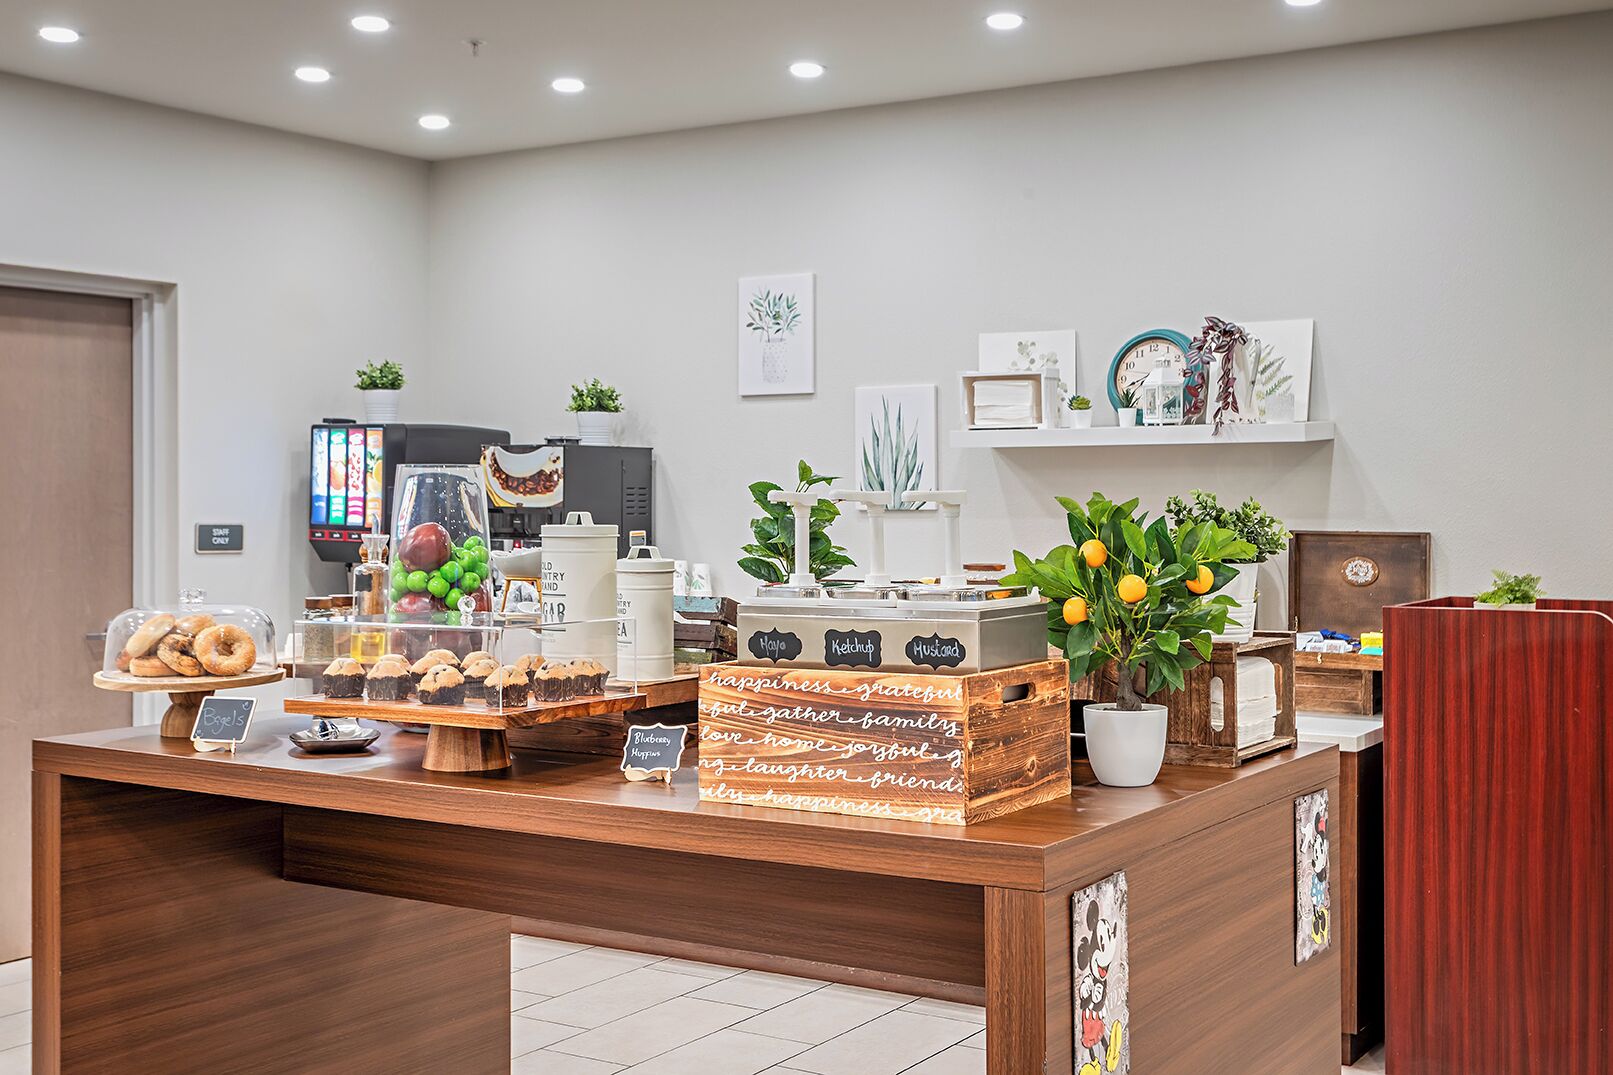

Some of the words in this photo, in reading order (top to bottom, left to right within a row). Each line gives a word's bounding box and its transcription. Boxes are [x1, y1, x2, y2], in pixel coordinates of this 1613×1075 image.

[1135, 350, 1144, 358] 11
[1149, 344, 1159, 352] 12
[1166, 346, 1170, 354] 1
[1125, 361, 1135, 370] 10
[1174, 355, 1180, 363] 2
[1121, 375, 1127, 384] 9
[212, 528, 230, 536] STAFF
[212, 537, 230, 545] ONLY
[760, 635, 787, 658] Mayo
[832, 637, 875, 662] Ketchup
[913, 639, 961, 659] Mustard
[702, 672, 838, 693] happiness
[854, 683, 963, 703] grateful
[203, 707, 245, 735] Bagels
[760, 706, 842, 724] gather
[858, 712, 961, 737] family
[699, 725, 745, 744] love
[760, 732, 827, 752] home
[840, 740, 930, 762] joyful
[744, 757, 851, 783] laughter
[762, 788, 895, 816] happiness
